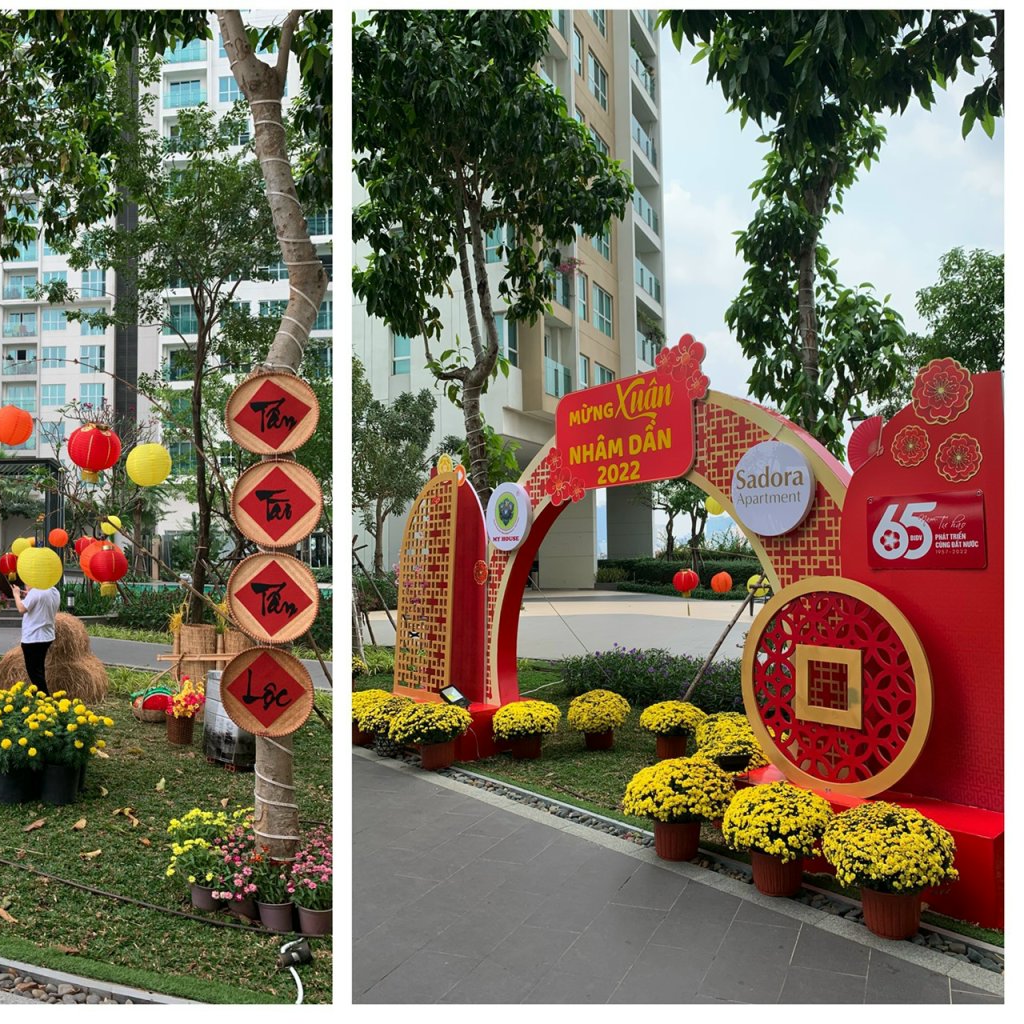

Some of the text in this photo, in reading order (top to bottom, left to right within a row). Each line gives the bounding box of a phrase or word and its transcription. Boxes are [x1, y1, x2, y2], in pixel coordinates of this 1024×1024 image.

[569, 377, 672, 426] MỪNG Xuân
[569, 419, 672, 465] NHÂM DẦN
[597, 460, 640, 485] 2022
[735, 466, 804, 490] Sadora
[737, 490, 801, 508] Apartment
[872, 501, 937, 560] 65
[242, 667, 292, 710] Lộc
